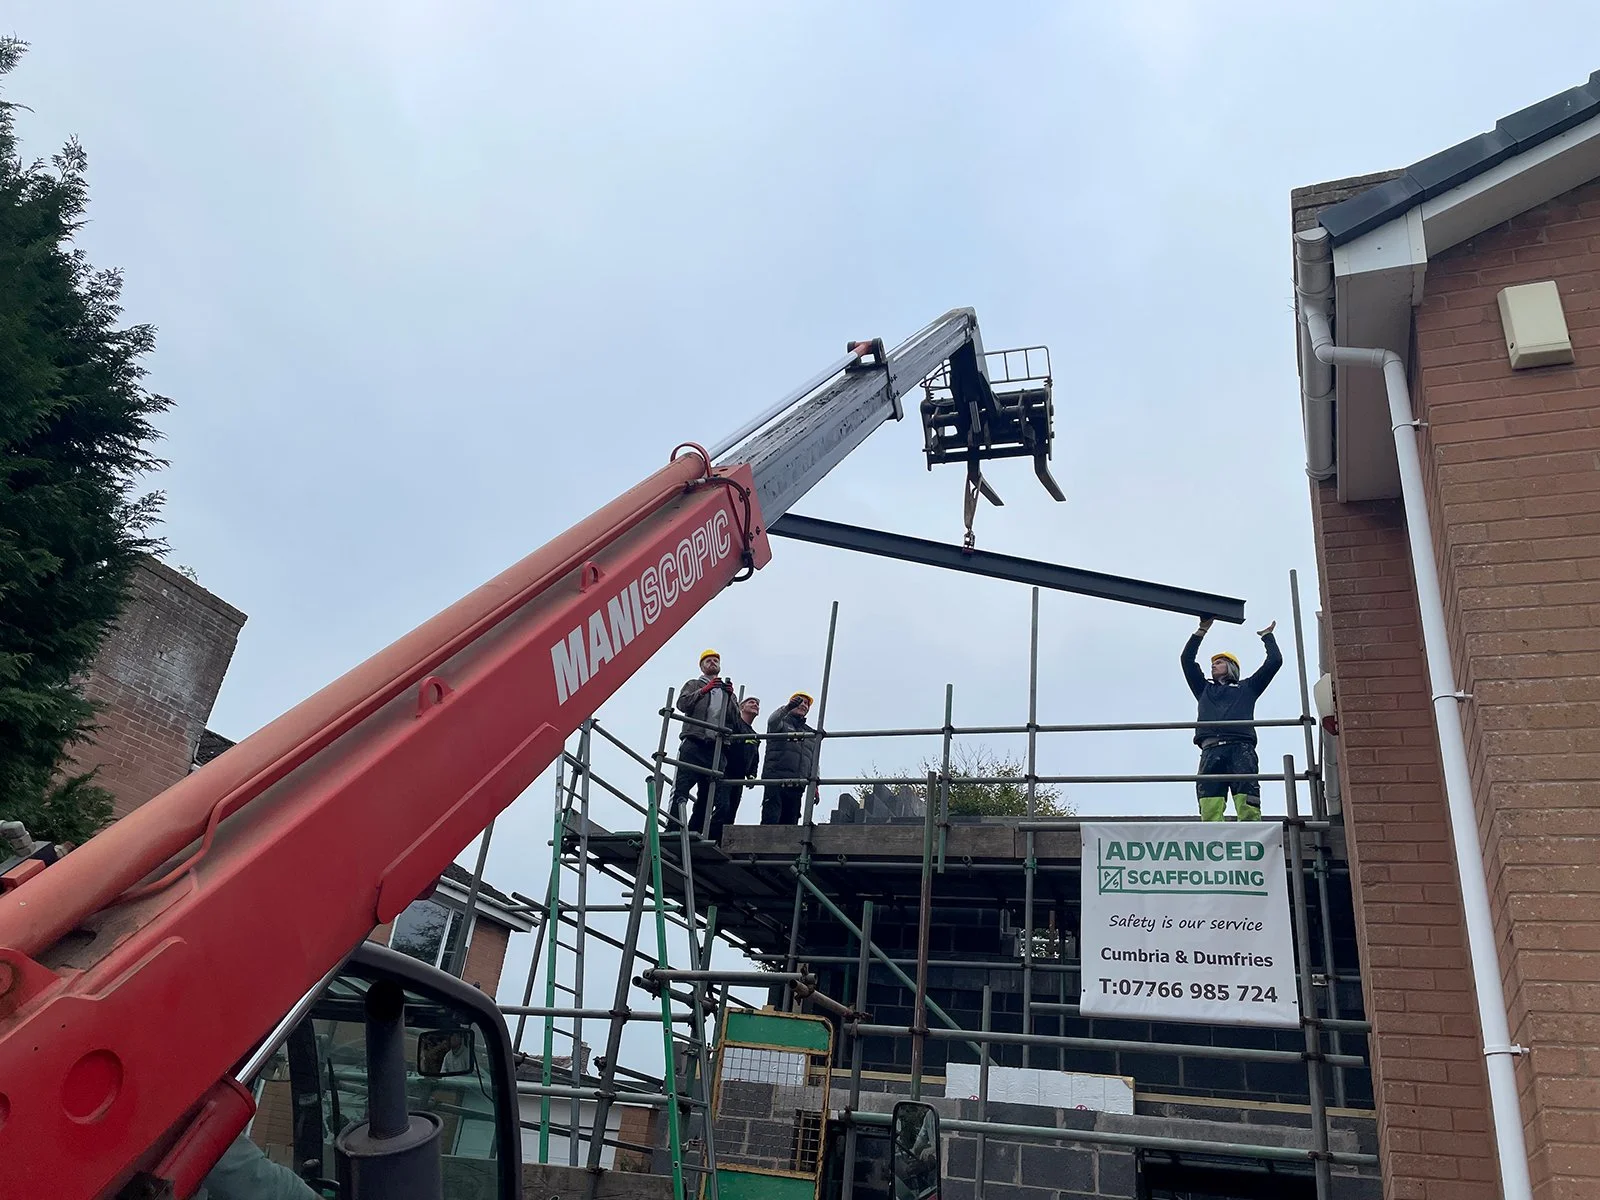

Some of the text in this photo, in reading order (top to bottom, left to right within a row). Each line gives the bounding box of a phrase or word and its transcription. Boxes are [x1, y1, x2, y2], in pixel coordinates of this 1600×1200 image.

[550, 508, 731, 706] MANISCOPIC
[1105, 841, 1265, 861] ADVANCED
[1127, 870, 1264, 887] SCAFFOLDING
[1109, 914, 1263, 932] Safety is our service
[1100, 947, 1274, 967] Cumbria & Dumfries
[1098, 978, 1278, 1003] T:07766 985 724
